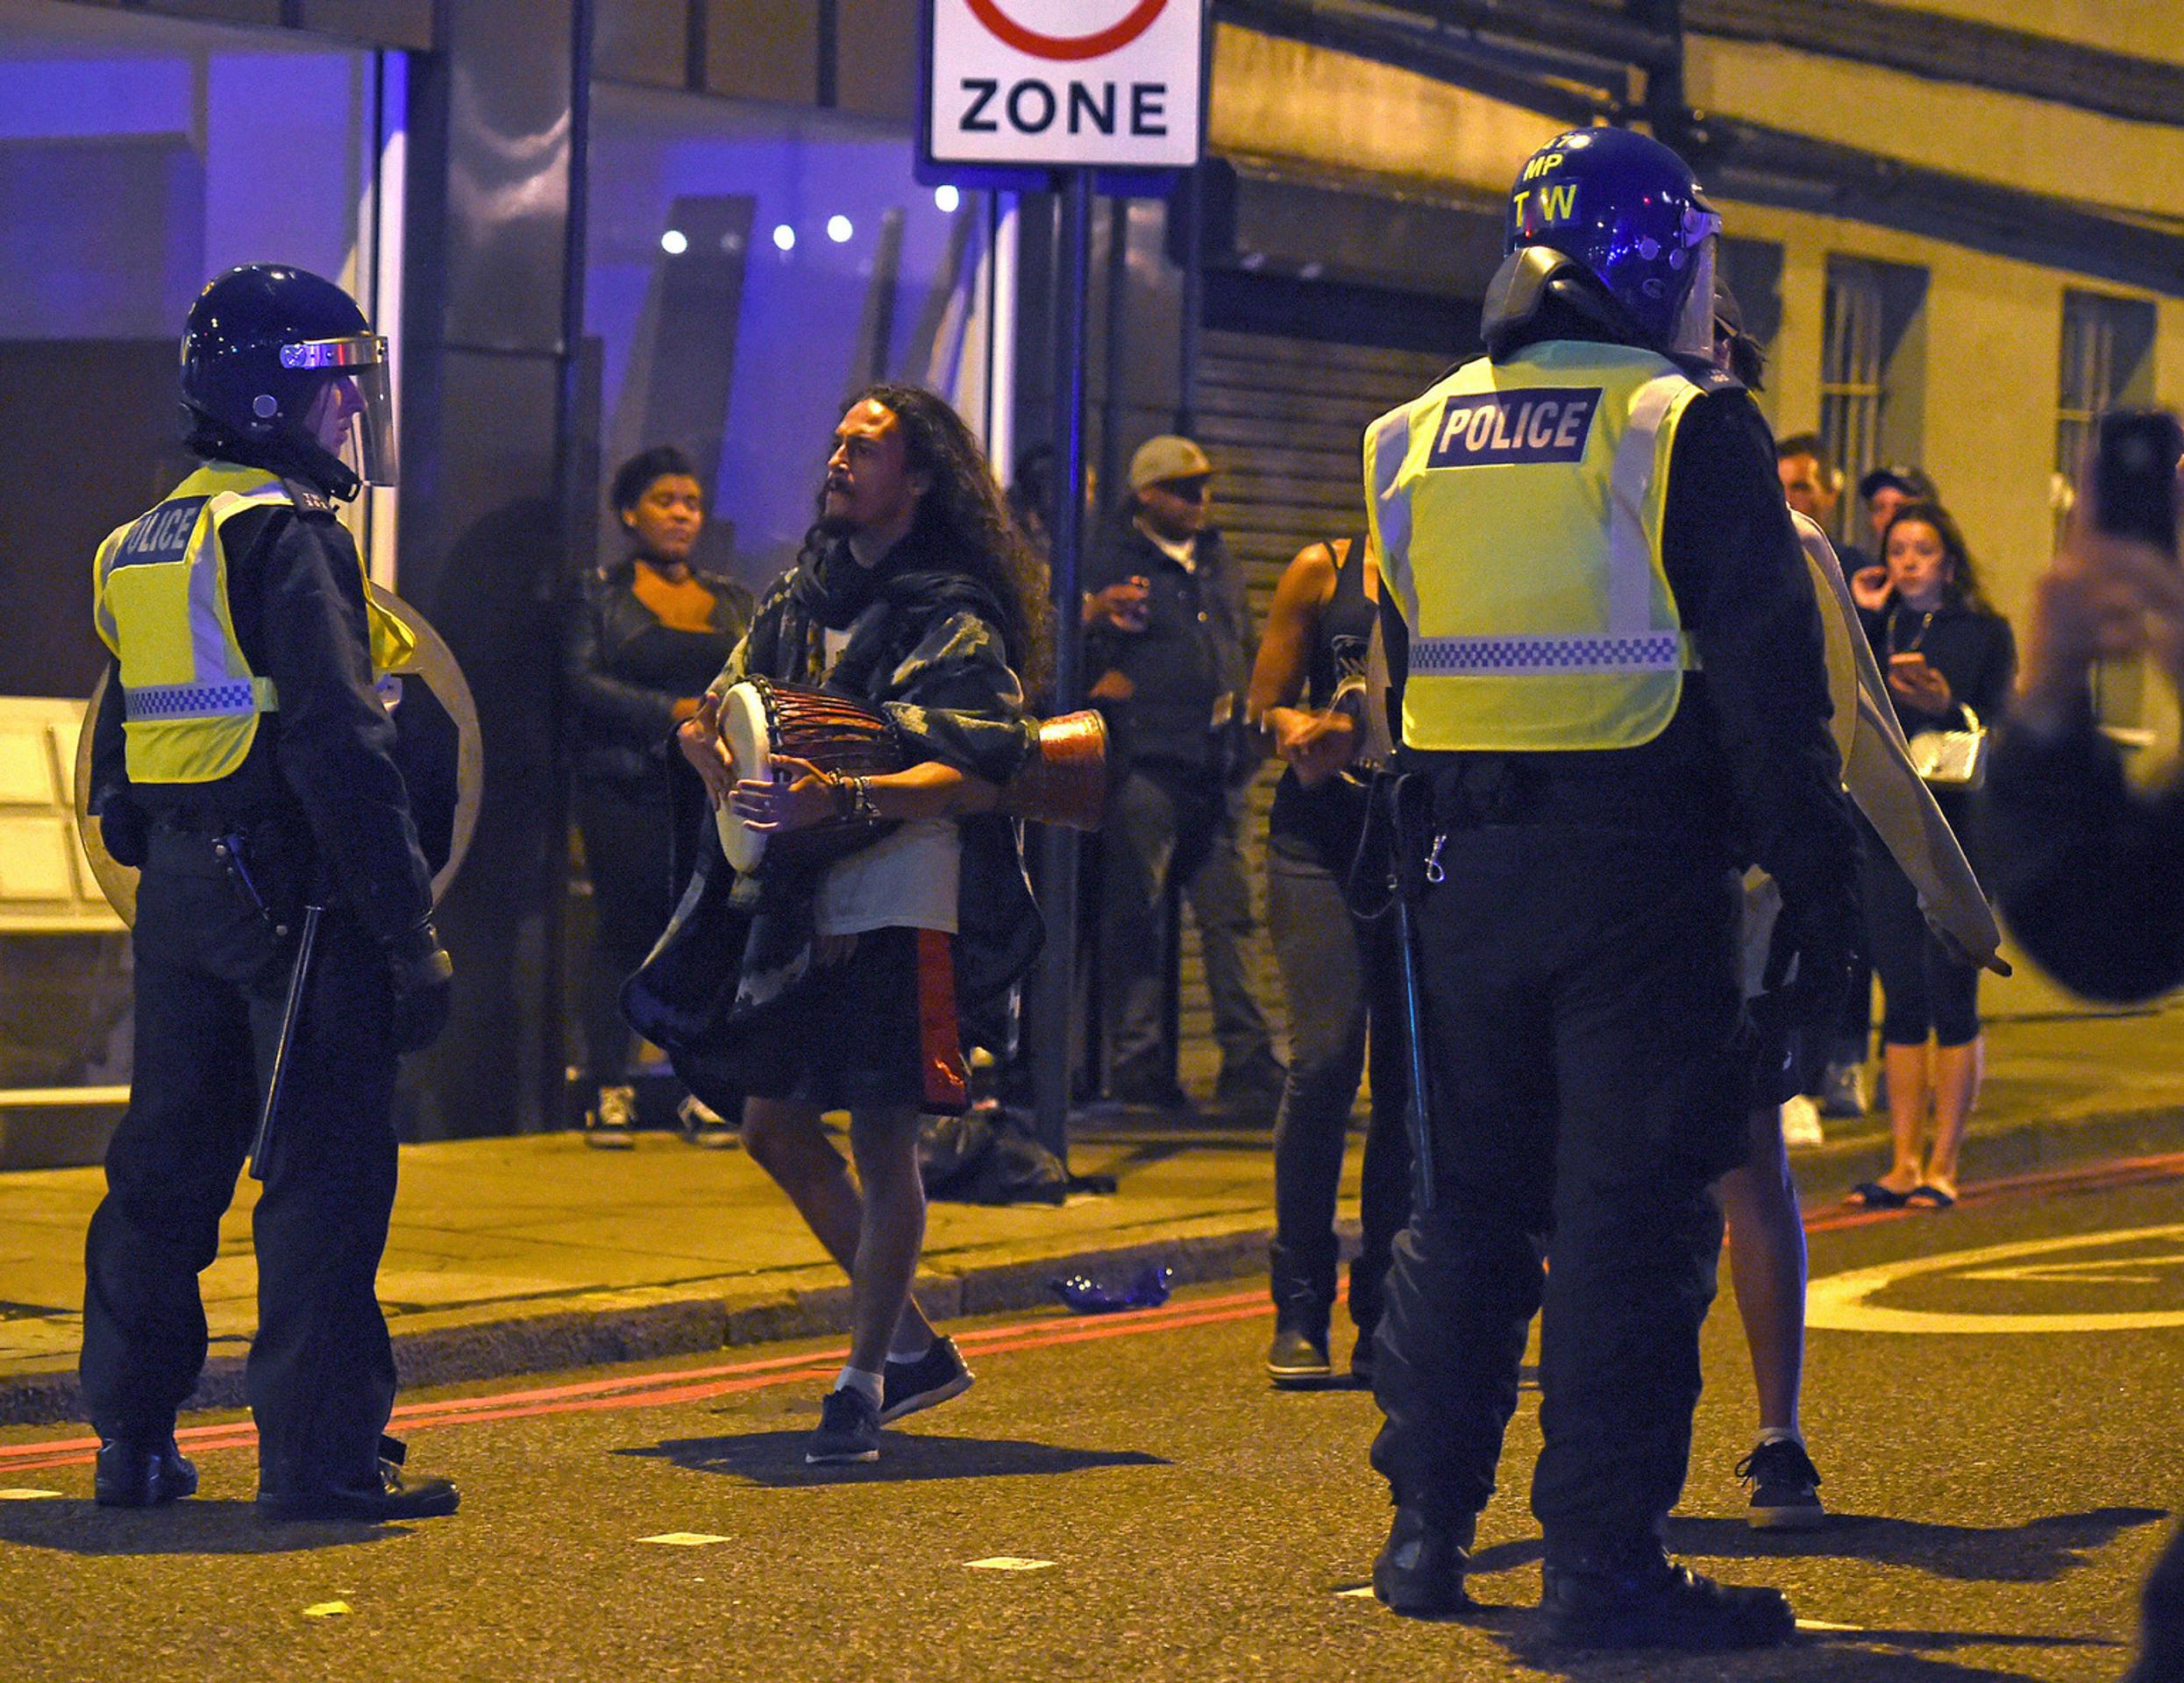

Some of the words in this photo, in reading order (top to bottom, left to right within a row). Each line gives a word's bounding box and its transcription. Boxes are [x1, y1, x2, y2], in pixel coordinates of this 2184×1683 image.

[958, 78, 1168, 136] ZONE
[1523, 153, 1563, 181] MP
[1438, 401, 1588, 453] POLICE
[126, 507, 197, 554] OLICE
